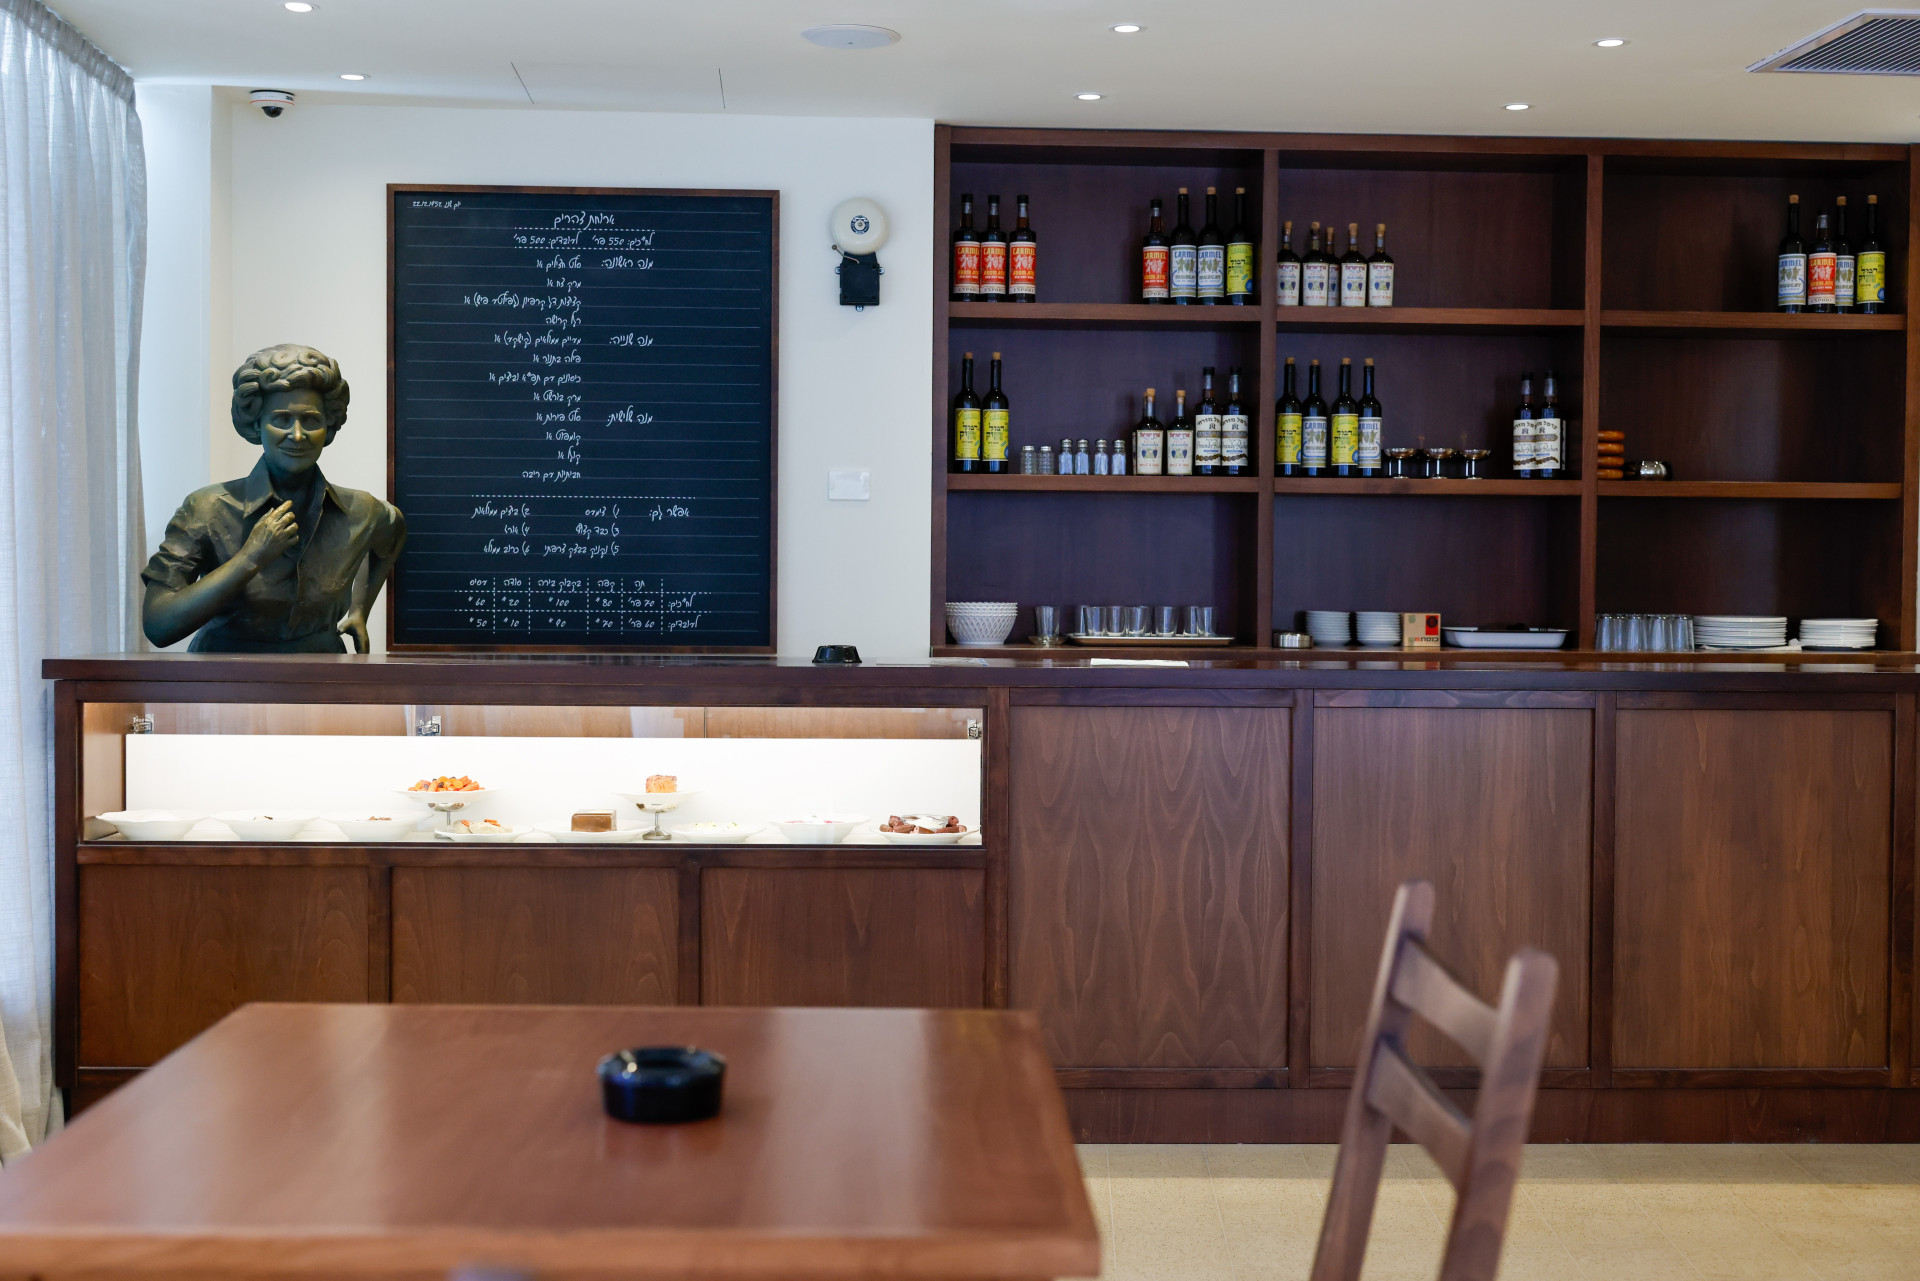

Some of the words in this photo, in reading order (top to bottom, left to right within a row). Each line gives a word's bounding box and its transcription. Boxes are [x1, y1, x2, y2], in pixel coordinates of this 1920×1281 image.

[554, 211, 585, 229] צהרים
[584, 213, 615, 230] ארוחת
[530, 236, 546, 244] 500
[609, 237, 624, 246] 550
[958, 247, 979, 255] CARMEL
[984, 247, 1005, 255] CARMEL
[1144, 252, 1166, 260] CARMEL
[1198, 251, 1222, 259] CARMEL
[536, 259, 543, 268] או
[546, 254, 566, 272] חצילים
[568, 255, 581, 268] סלט
[601, 256, 634, 269] ראשונה:
[637, 258, 654, 270] מנה
[546, 278, 553, 287] או
[556, 277, 565, 287] צח
[567, 280, 582, 292] מרק
[464, 295, 470, 304] או
[522, 296, 546, 311] קרפיון
[548, 296, 557, 309] דג
[546, 314, 567, 330] קרושה
[571, 311, 581, 328] רגל
[494, 334, 501, 343] או
[561, 336, 581, 348] מעיים
[637, 335, 653, 346] מנה
[533, 354, 539, 363] או
[542, 354, 561, 366] בתנור
[489, 372, 495, 381] או
[543, 376, 555, 386] עם
[533, 392, 540, 401] או
[543, 389, 564, 402] בורשט
[567, 394, 581, 407] מרק
[536, 412, 542, 421] או
[542, 412, 565, 425] פירות
[568, 408, 581, 421] סלט
[637, 413, 653, 424] מנה
[1358, 422, 1379, 430] ARMEL
[546, 432, 552, 440] או
[555, 429, 581, 446] קומפוט
[558, 451, 564, 459] או
[567, 446, 581, 465] קוגל
[522, 470, 540, 479] ריבה
[543, 472, 554, 483] עם
[500, 505, 519, 519] ביצים
[585, 506, 606, 517] צימעס
[649, 504, 663, 522] גם:
[667, 504, 689, 517] אפשר
[504, 524, 519, 534] אורז
[575, 522, 591, 540] קצוץ
[594, 526, 608, 535] כבד
[503, 544, 519, 554] כרוב
[543, 543, 566, 556] צרפתי
[568, 543, 587, 558] בבצק
[590, 545, 609, 558] נקניק
[469, 578, 488, 586] עסיס
[503, 578, 522, 586] סודה
[559, 578, 582, 593] בקבוק
[597, 579, 615, 592] קפה
[634, 580, 645, 591] תה
[475, 598, 486, 606] 60
[555, 599, 570, 607] 100
[476, 619, 487, 627] 50
[602, 620, 613, 628] 70
[645, 620, 655, 628] 60
